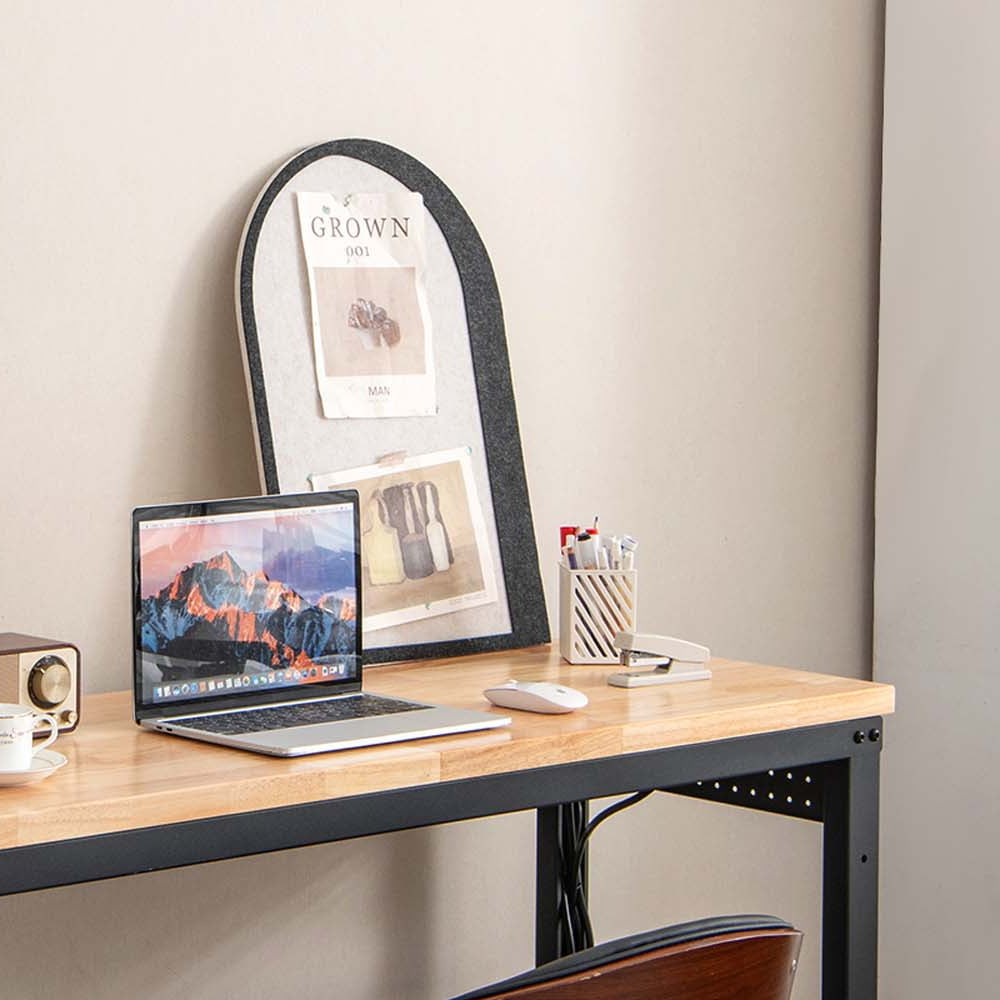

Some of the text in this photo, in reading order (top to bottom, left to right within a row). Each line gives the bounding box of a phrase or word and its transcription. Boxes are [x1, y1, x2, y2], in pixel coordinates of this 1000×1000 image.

[311, 216, 410, 239] GROWN
[345, 246, 370, 257] 001
[368, 386, 391, 397] MAN
